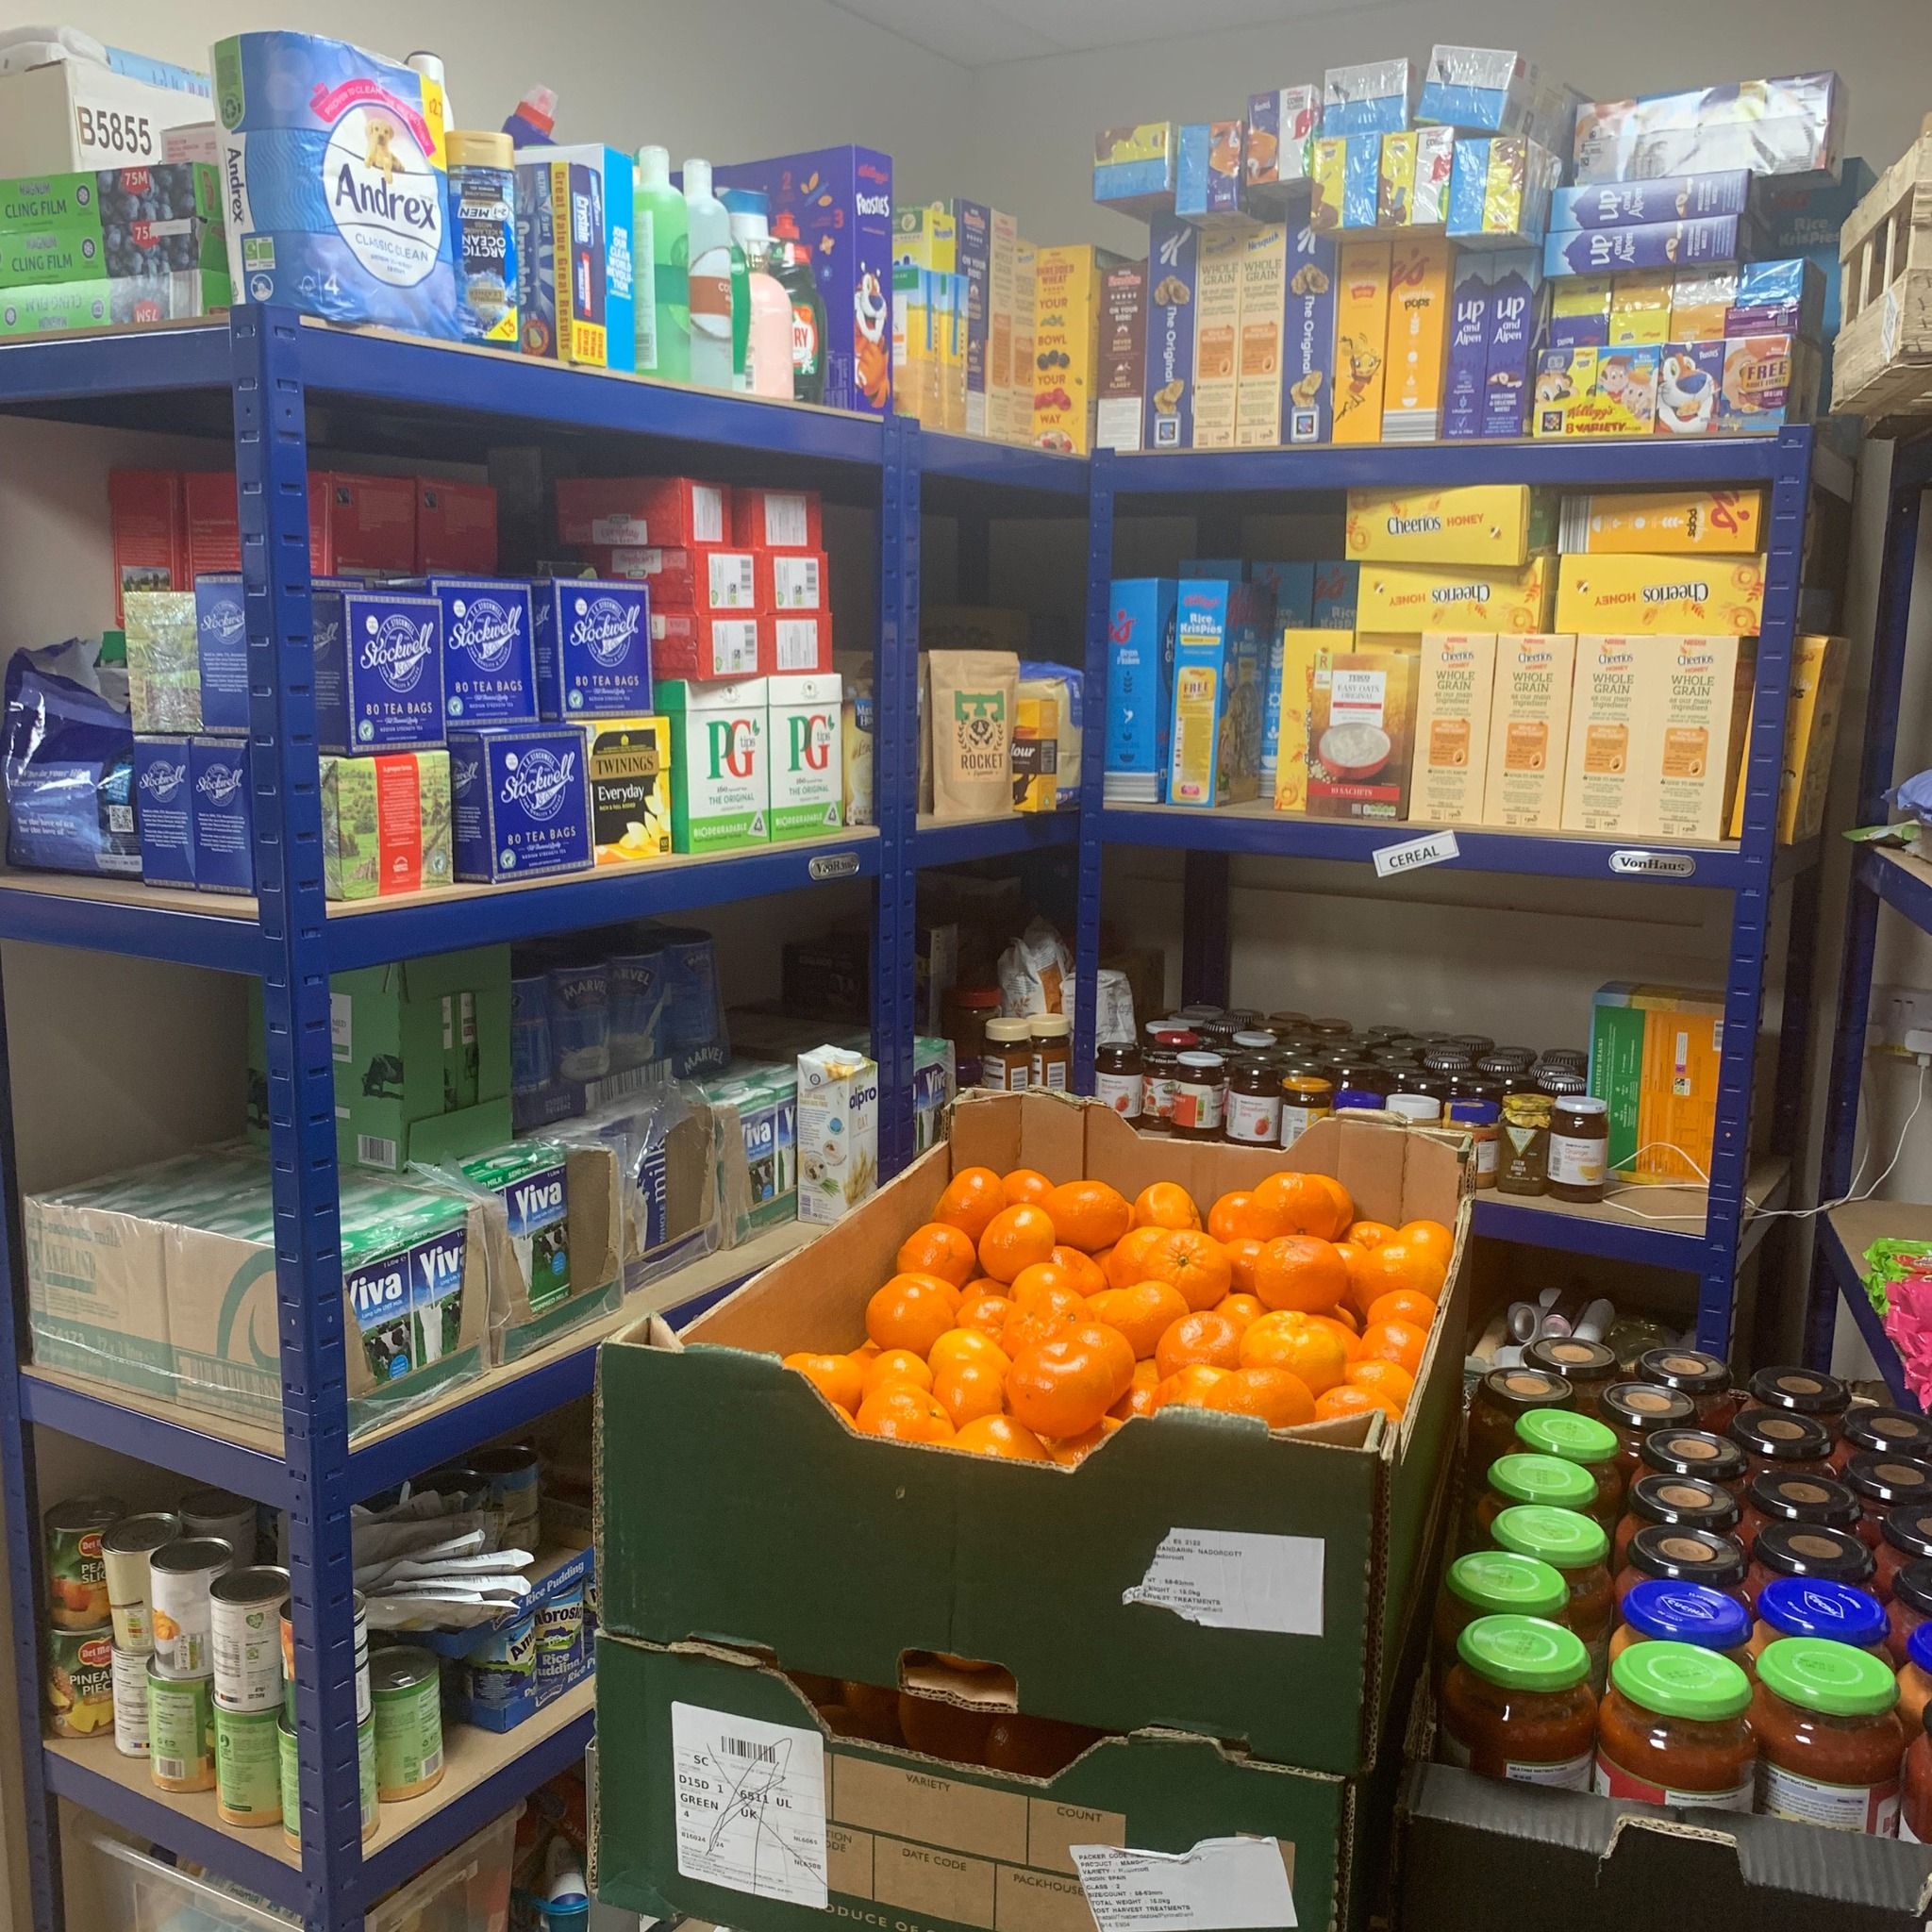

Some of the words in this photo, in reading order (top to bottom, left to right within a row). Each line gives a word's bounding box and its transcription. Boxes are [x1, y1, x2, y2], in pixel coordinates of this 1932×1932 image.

[76, 106, 152, 156] B5855
[125, 171, 148, 186] 75M
[227, 147, 243, 223] Andrex
[336, 163, 437, 231] Andrex
[556, 172, 565, 213] Great
[5, 203, 39, 219] CLING
[41, 199, 67, 214] FILM
[856, 192, 891, 218] FROSTIES
[1623, 192, 1633, 211] and
[1627, 187, 1645, 219] Alpen
[460, 207, 490, 218] MEN
[576, 196, 589, 243] Crystale
[834, 208, 844, 228] 3
[135, 225, 158, 241] 75
[461, 236, 507, 246] OCEAN
[557, 214, 566, 252] Value
[356, 233, 394, 255] CLASSIC
[394, 245, 429, 262] CLEAN
[1247, 233, 1279, 252] Nesquik
[1614, 236, 1623, 256] and
[1619, 232, 1637, 264] Alpen
[462, 246, 507, 258] ARCTIC
[11, 257, 44, 273] CLING
[47, 254, 73, 269] FILM
[1243, 259, 1282, 271] WHOLE
[324, 275, 340, 294] 4
[558, 258, 568, 294] Great
[1041, 275, 1067, 285] WHEAT
[1245, 270, 1279, 282] GRAIN
[1039, 298, 1068, 309] YOUR
[1304, 295, 1315, 318] The
[1404, 297, 1430, 310] pops
[560, 300, 570, 350] Results
[1166, 306, 1177, 327] The
[1502, 318, 1521, 330] and
[1463, 321, 1480, 333] and
[1492, 327, 1523, 344] Alpen
[1038, 334, 1067, 345] BOWL
[1454, 330, 1482, 347] Alpen
[1301, 321, 1314, 375] Original
[1163, 332, 1176, 383] Original
[1747, 360, 1788, 380] FREE
[1038, 375, 1066, 386] YOUR
[1040, 414, 1061, 425] WAY
[1567, 405, 1614, 420] Kellogg's
[1566, 422, 1574, 433] 8
[1575, 422, 1626, 433] VARIETY
[1387, 515, 1441, 536] Cheerios
[1446, 513, 1485, 527] HONEY
[1687, 508, 1698, 539] pops
[1389, 593, 1426, 607] HONEY
[1432, 584, 1491, 605] Cheerios
[1594, 591, 1637, 608] HONEY
[1642, 583, 1709, 604] Cheerios
[1190, 613, 1212, 625] Rice
[448, 605, 523, 653] Stockwell
[570, 605, 641, 651] Stockwell
[1180, 623, 1223, 635] KrisPies
[360, 621, 435, 673] Stockwell
[1441, 651, 1474, 661] Cheerios
[1518, 652, 1553, 663] Cheerios
[575, 675, 589, 687] 80
[591, 675, 611, 687] TEA
[614, 675, 640, 687] BAGS
[1436, 671, 1475, 681] WHOLE
[1513, 673, 1553, 683] WHOLE
[1592, 674, 1635, 684] WHOLE
[1671, 675, 1715, 686] WHOLE
[455, 680, 469, 692] 80
[473, 679, 493, 692] TEA
[496, 679, 523, 691] BAGS
[1337, 685, 1357, 693] EASY
[1357, 685, 1380, 693] OATS
[1437, 680, 1472, 691] GRAIN
[1513, 682, 1550, 692] GRAIN
[1593, 684, 1630, 694] GRAIN
[1673, 686, 1710, 696] GRAIN
[1341, 692, 1373, 701] ORIGINAL
[366, 704, 379, 716] 80
[384, 703, 405, 715] TEA
[407, 702, 434, 714] BAGS
[740, 734, 756, 748] tips
[787, 714, 830, 773] PG
[817, 731, 831, 742] tips
[706, 719, 754, 780] PG
[595, 757, 654, 774] TWININGS
[960, 754, 1003, 770] ROCKET
[501, 751, 575, 801] Stockwell
[597, 784, 644, 804] Everyday
[789, 788, 800, 796] THE
[801, 785, 829, 795] ORIGINAL
[1340, 788, 1374, 797] SACHETS
[708, 796, 722, 806] THE
[723, 793, 755, 804] ORIGINAL
[775, 813, 823, 825] BIODEGRADABLE
[508, 834, 522, 845] 80
[525, 830, 545, 843] TEA
[549, 826, 576, 841] BAGS
[693, 823, 748, 839] BIODEGRADABLE
[1389, 844, 1441, 869] CEREAL
[1620, 857, 1686, 872] VonHaus
[684, 1046, 724, 1074] MARVEL
[1594, 1065, 1603, 1096] SELECTED
[850, 1085, 877, 1111] alpro
[1240, 1105, 1270, 1114] Strawberry
[857, 1115, 869, 1128] OAT
[515, 1181, 562, 1216] Viva
[1198, 1549, 1242, 1557] NADORCOTT
[81, 1563, 106, 1574] PEA
[82, 1574, 107, 1584] SLIC
[525, 1589, 545, 1607] Rice
[546, 1561, 585, 1592] Pudding
[1174, 1596, 1221, 1605] TREATMENTS
[1666, 1598, 1707, 1618] CUCINA
[1807, 1594, 1840, 1616] CUCINA
[542, 1652, 570, 1666] Rice
[69, 1670, 111, 1685] PINEA
[693, 1755, 709, 1767] SC
[678, 1774, 709, 1790] D15D
[717, 1784, 724, 1793] 1
[776, 1797, 792, 1808] UL
[906, 1774, 951, 1792] VARIETY
[680, 1793, 719, 1810] GREEN
[741, 1808, 758, 1820] UK
[1056, 1806, 1103, 1824] COUNT
[902, 1848, 929, 1863] DATE
[934, 1856, 967, 1872] CODE
[1013, 1874, 1084, 1896] PACKHOUSE
